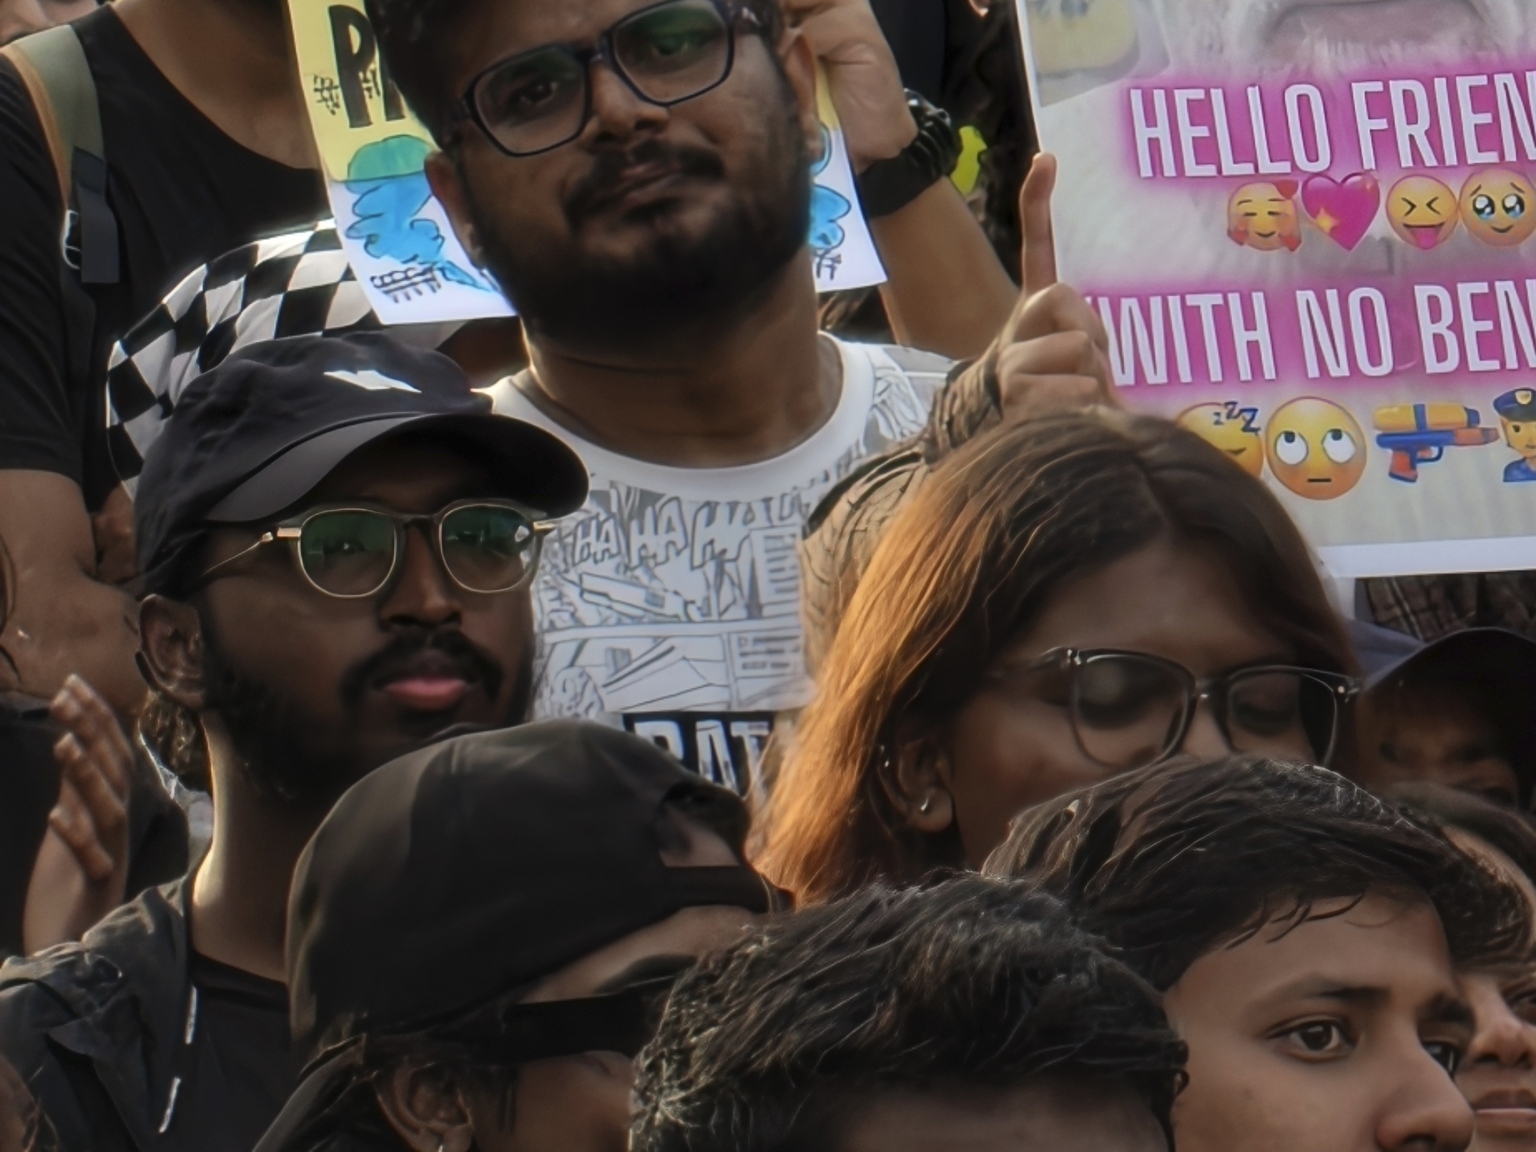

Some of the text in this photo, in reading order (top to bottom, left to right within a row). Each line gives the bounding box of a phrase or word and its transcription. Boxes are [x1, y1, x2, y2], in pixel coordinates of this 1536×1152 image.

[1129, 84, 1332, 178] HELLO
[1085, 291, 1276, 386] WITH
[1297, 286, 1395, 378] NO
